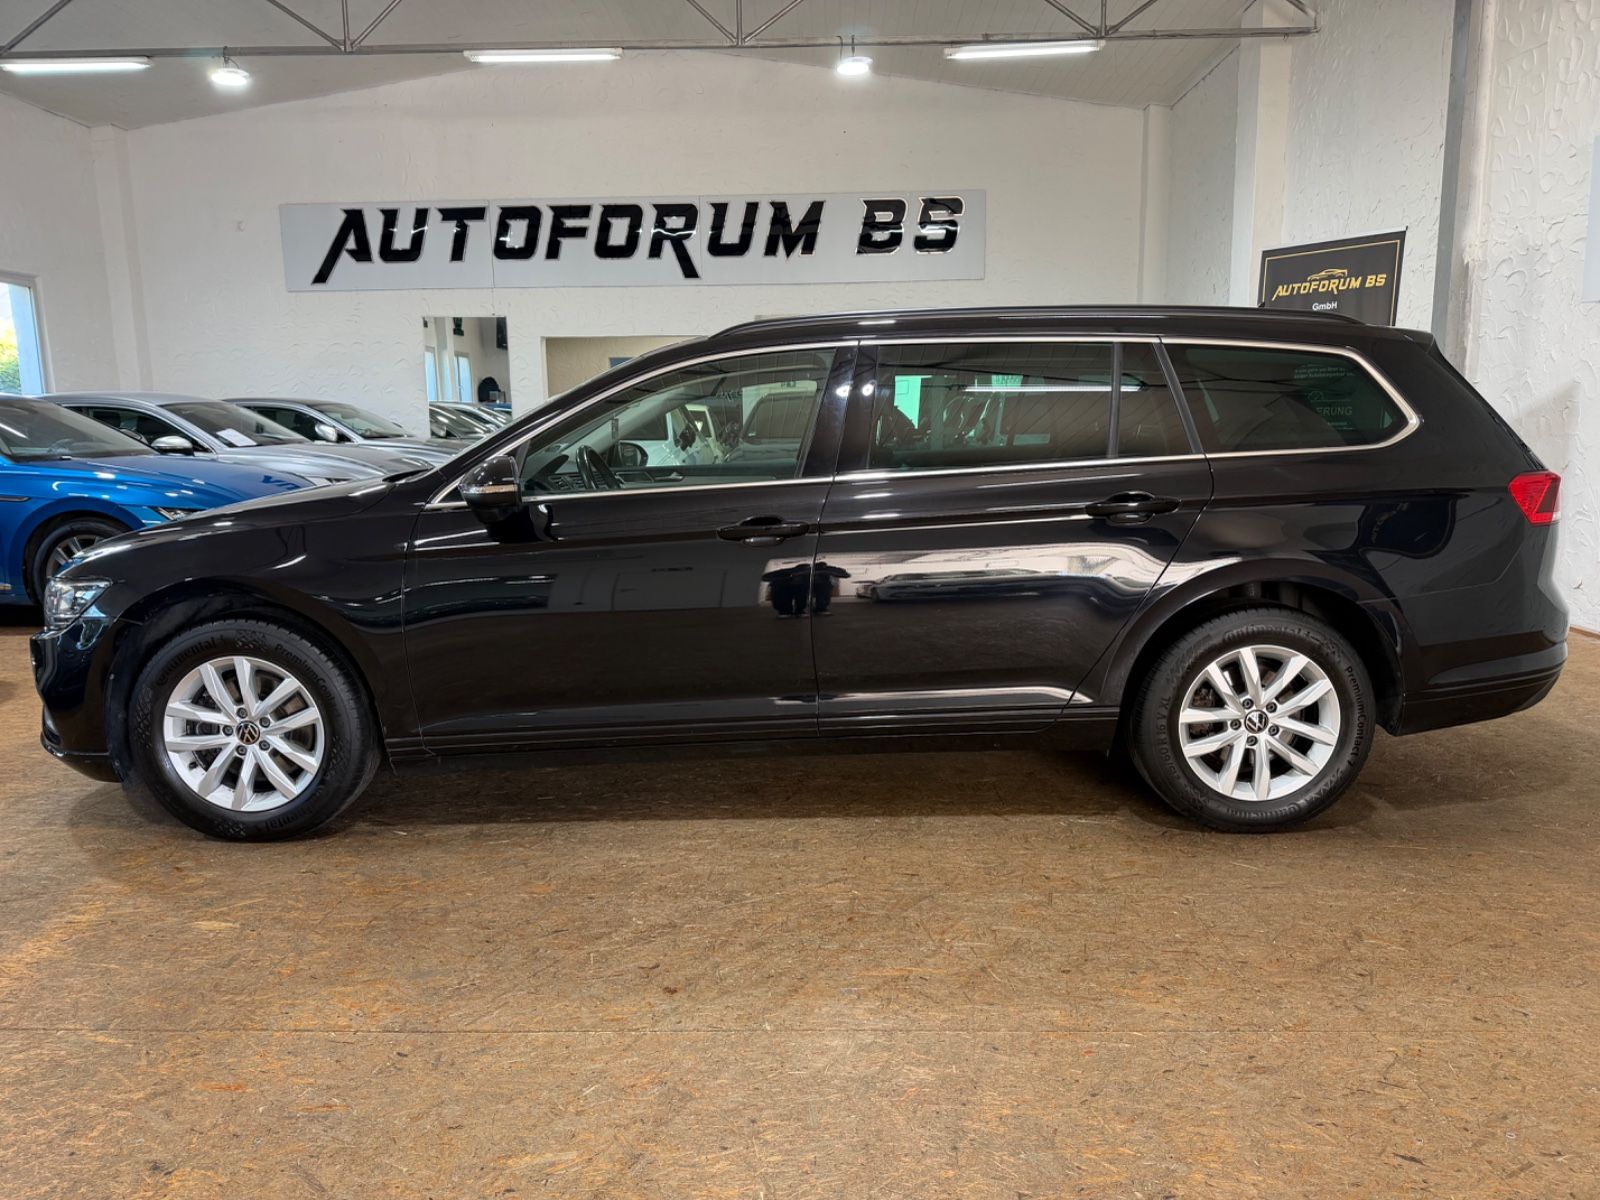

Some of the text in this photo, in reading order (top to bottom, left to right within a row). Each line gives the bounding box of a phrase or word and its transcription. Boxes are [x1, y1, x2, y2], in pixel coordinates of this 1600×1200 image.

[311, 196, 965, 285] AUTOFORUM BS
[1272, 273, 1387, 301] AUTOFORUM BS
[1312, 301, 1338, 311] GmbH
[1344, 665, 1367, 756] PremiumContact
